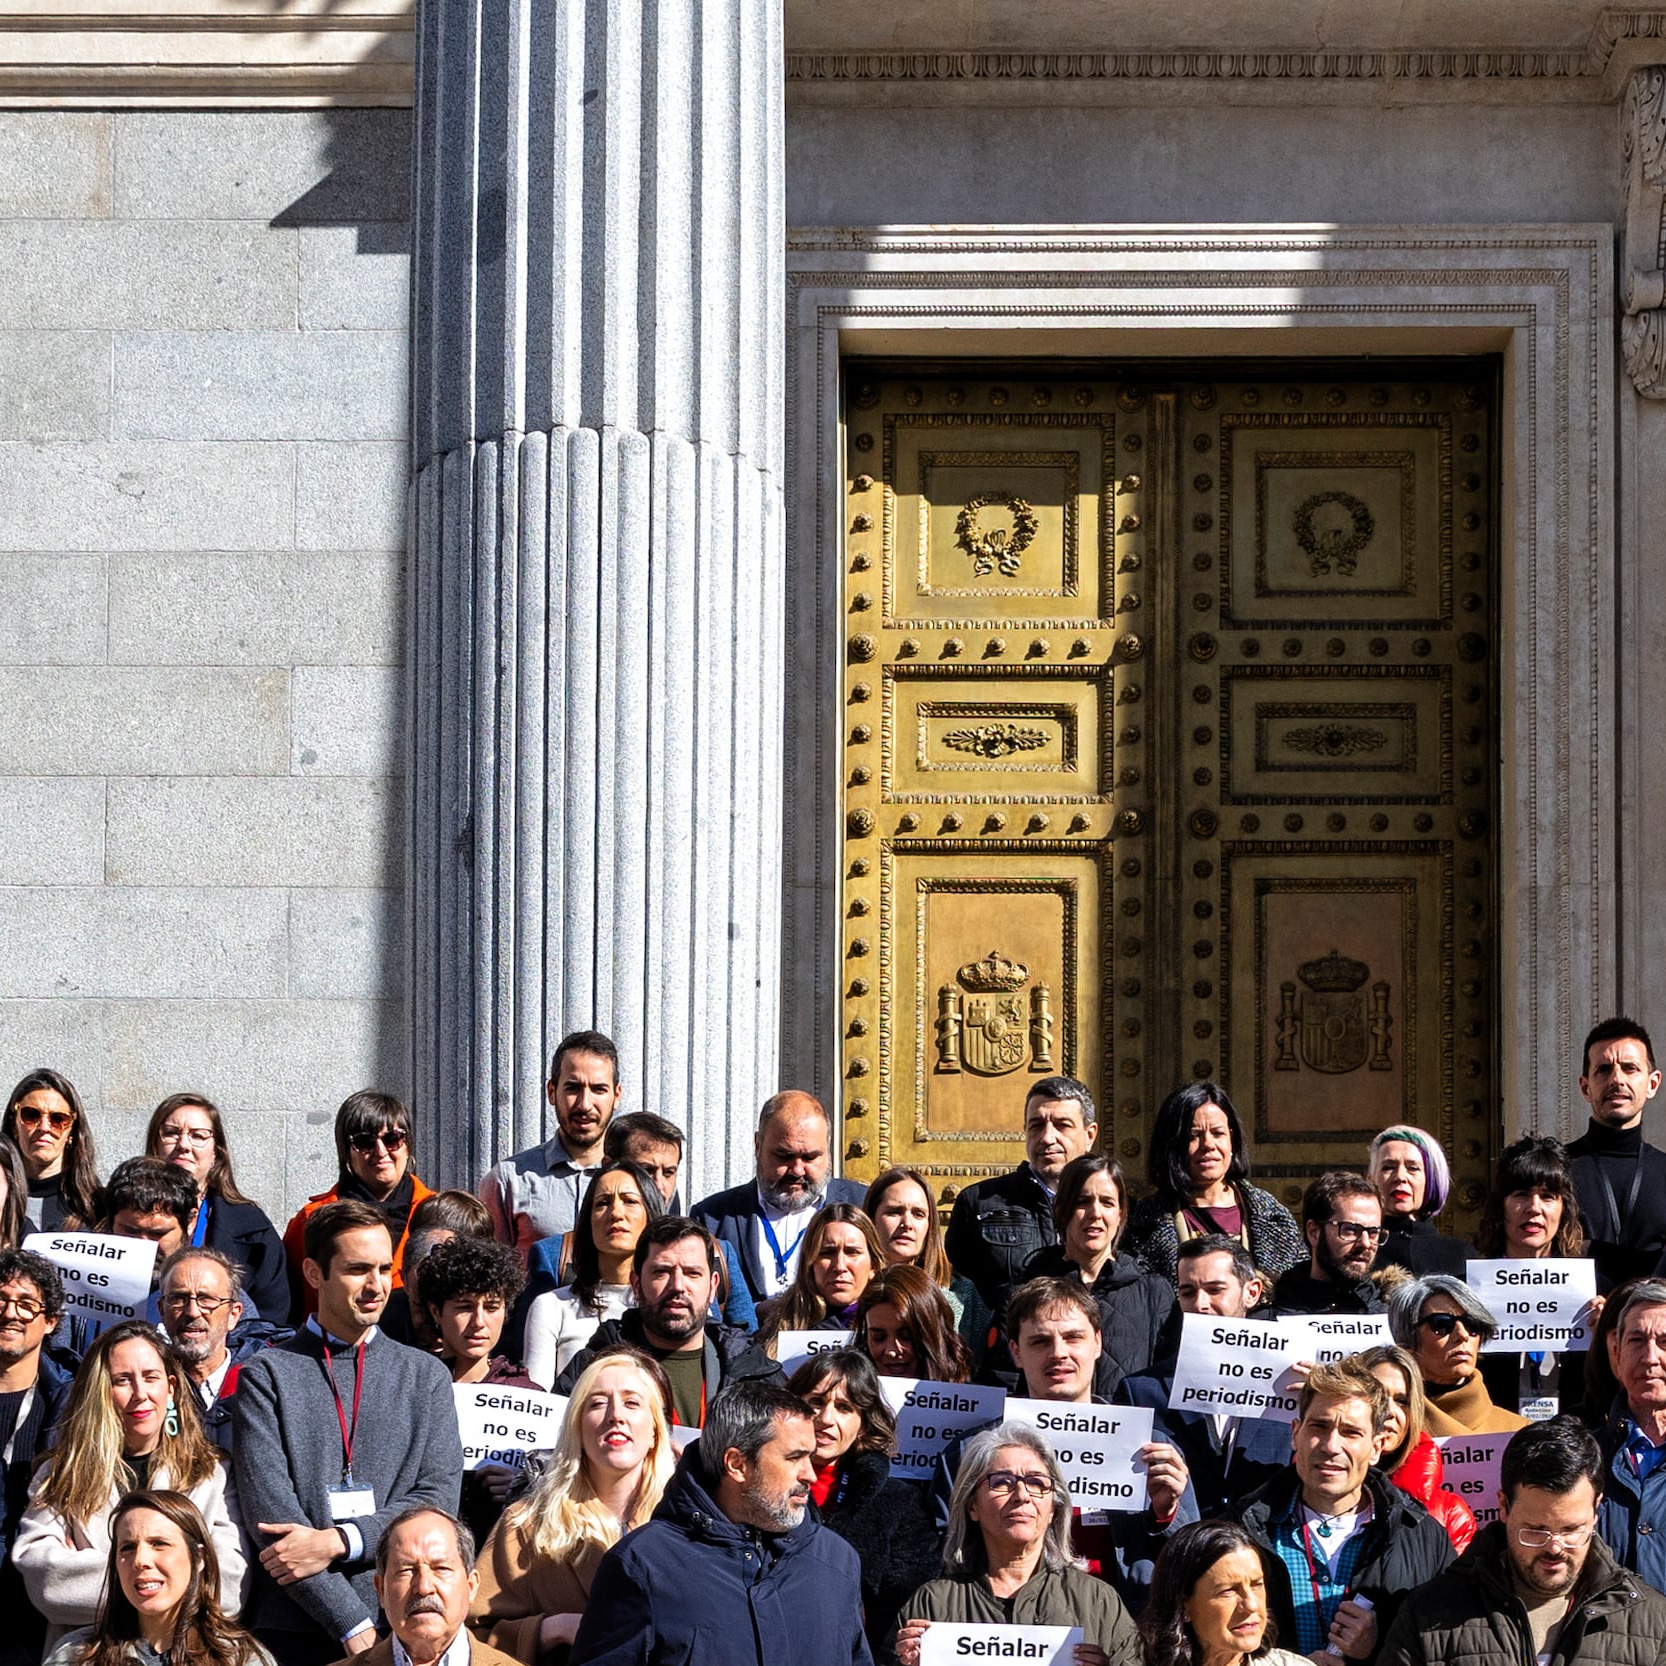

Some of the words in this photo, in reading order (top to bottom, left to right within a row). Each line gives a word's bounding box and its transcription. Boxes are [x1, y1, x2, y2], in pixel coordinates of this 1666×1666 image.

[49, 1239, 127, 1261] Señalar
[59, 1266, 82, 1281] no
[86, 1272, 110, 1287] es
[1495, 1268, 1570, 1286] Señalar
[65, 1293, 135, 1318] odismo
[1506, 1301, 1531, 1314] no
[1536, 1301, 1558, 1314] es
[1211, 1327, 1289, 1351] Señalar
[1493, 1322, 1584, 1342] eriodismo
[1218, 1362, 1245, 1378] no
[1250, 1366, 1274, 1380] es
[474, 1393, 554, 1418] Señalar
[904, 1389, 979, 1413] Señalar
[1183, 1383, 1297, 1412] periodismo
[483, 1421, 508, 1437] no
[515, 1428, 537, 1443] es
[911, 1422, 936, 1439] no
[1035, 1412, 1121, 1435] Señalar
[463, 1443, 527, 1469] eriodis
[890, 1447, 939, 1469] eriod
[1079, 1451, 1105, 1466] es
[1441, 1445, 1494, 1465] ñalar
[1068, 1475, 1134, 1498] dismo
[1460, 1480, 1485, 1494] es
[956, 1636, 1049, 1658] Señalar
